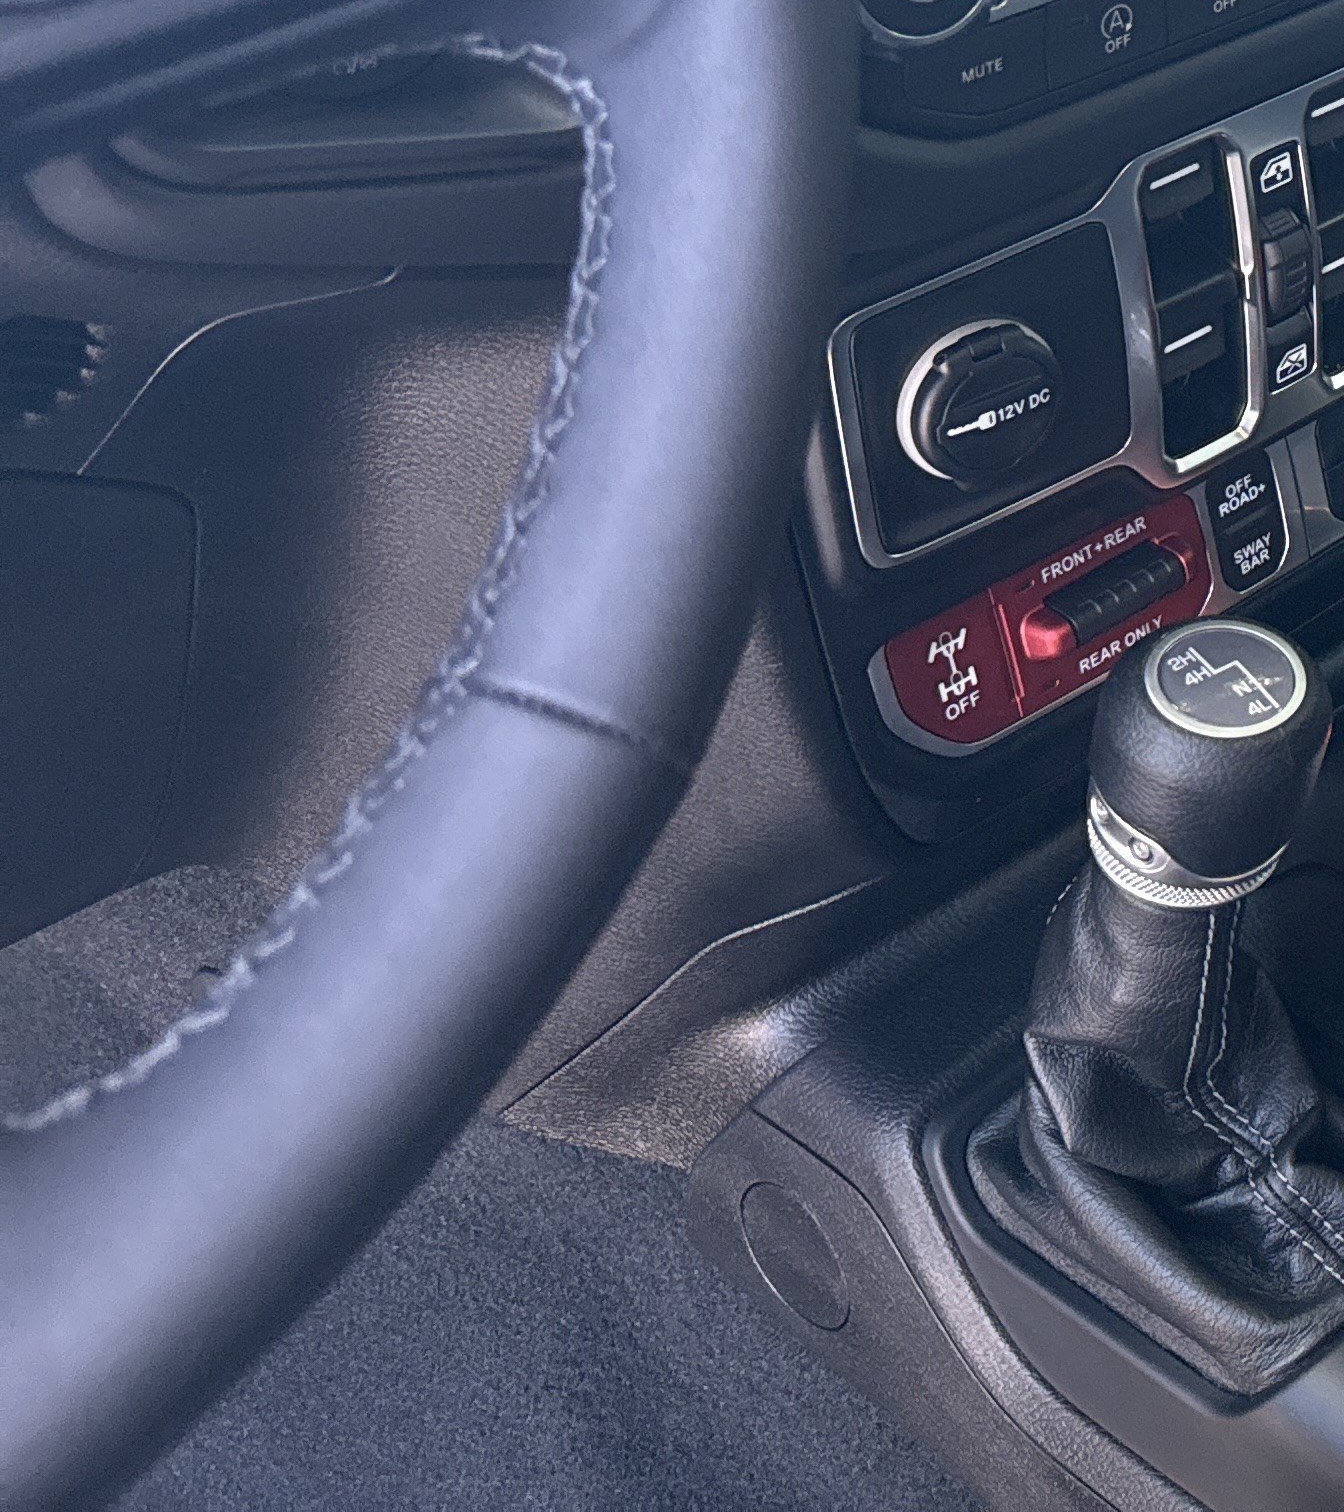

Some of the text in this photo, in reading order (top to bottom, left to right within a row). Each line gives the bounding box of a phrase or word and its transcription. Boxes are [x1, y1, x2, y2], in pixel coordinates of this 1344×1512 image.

[1105, 33, 1132, 54] OFF
[961, 56, 1004, 84] MUTE
[996, 388, 1050, 422] 12V DC
[1225, 474, 1252, 497] OFF
[1233, 532, 1272, 564] SWAY
[1240, 548, 1271, 575] BAR
[1078, 614, 1164, 675] REAR ONLY
[1167, 651, 1197, 672] 2H
[1184, 665, 1213, 687] 4H
[944, 691, 983, 721] OFF
[1248, 699, 1274, 716] 4L
